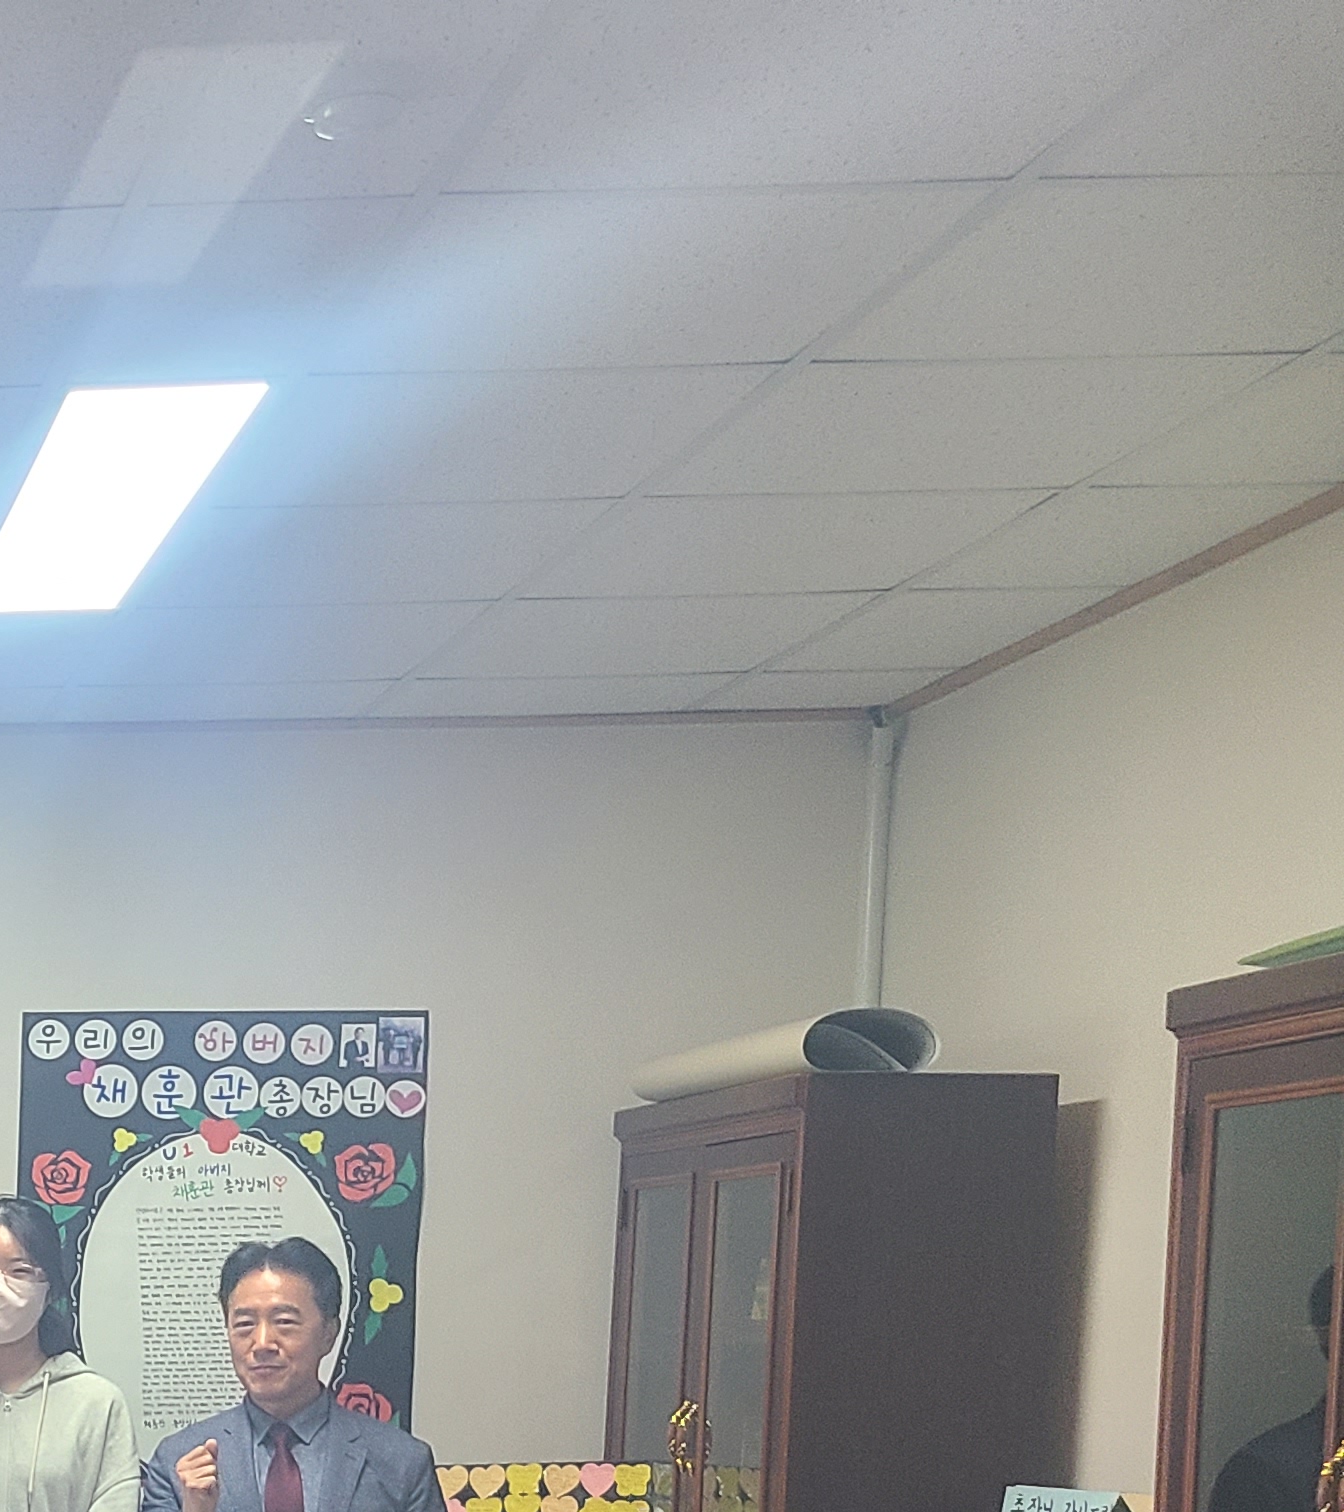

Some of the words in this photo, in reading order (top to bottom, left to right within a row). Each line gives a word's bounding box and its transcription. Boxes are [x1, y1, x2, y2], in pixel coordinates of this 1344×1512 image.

[35, 1024, 157, 1055] 우리의
[95, 1068, 253, 1116] 채훈관
[268, 1079, 378, 1117] 총장님
[231, 1140, 268, 1157] 대학교
